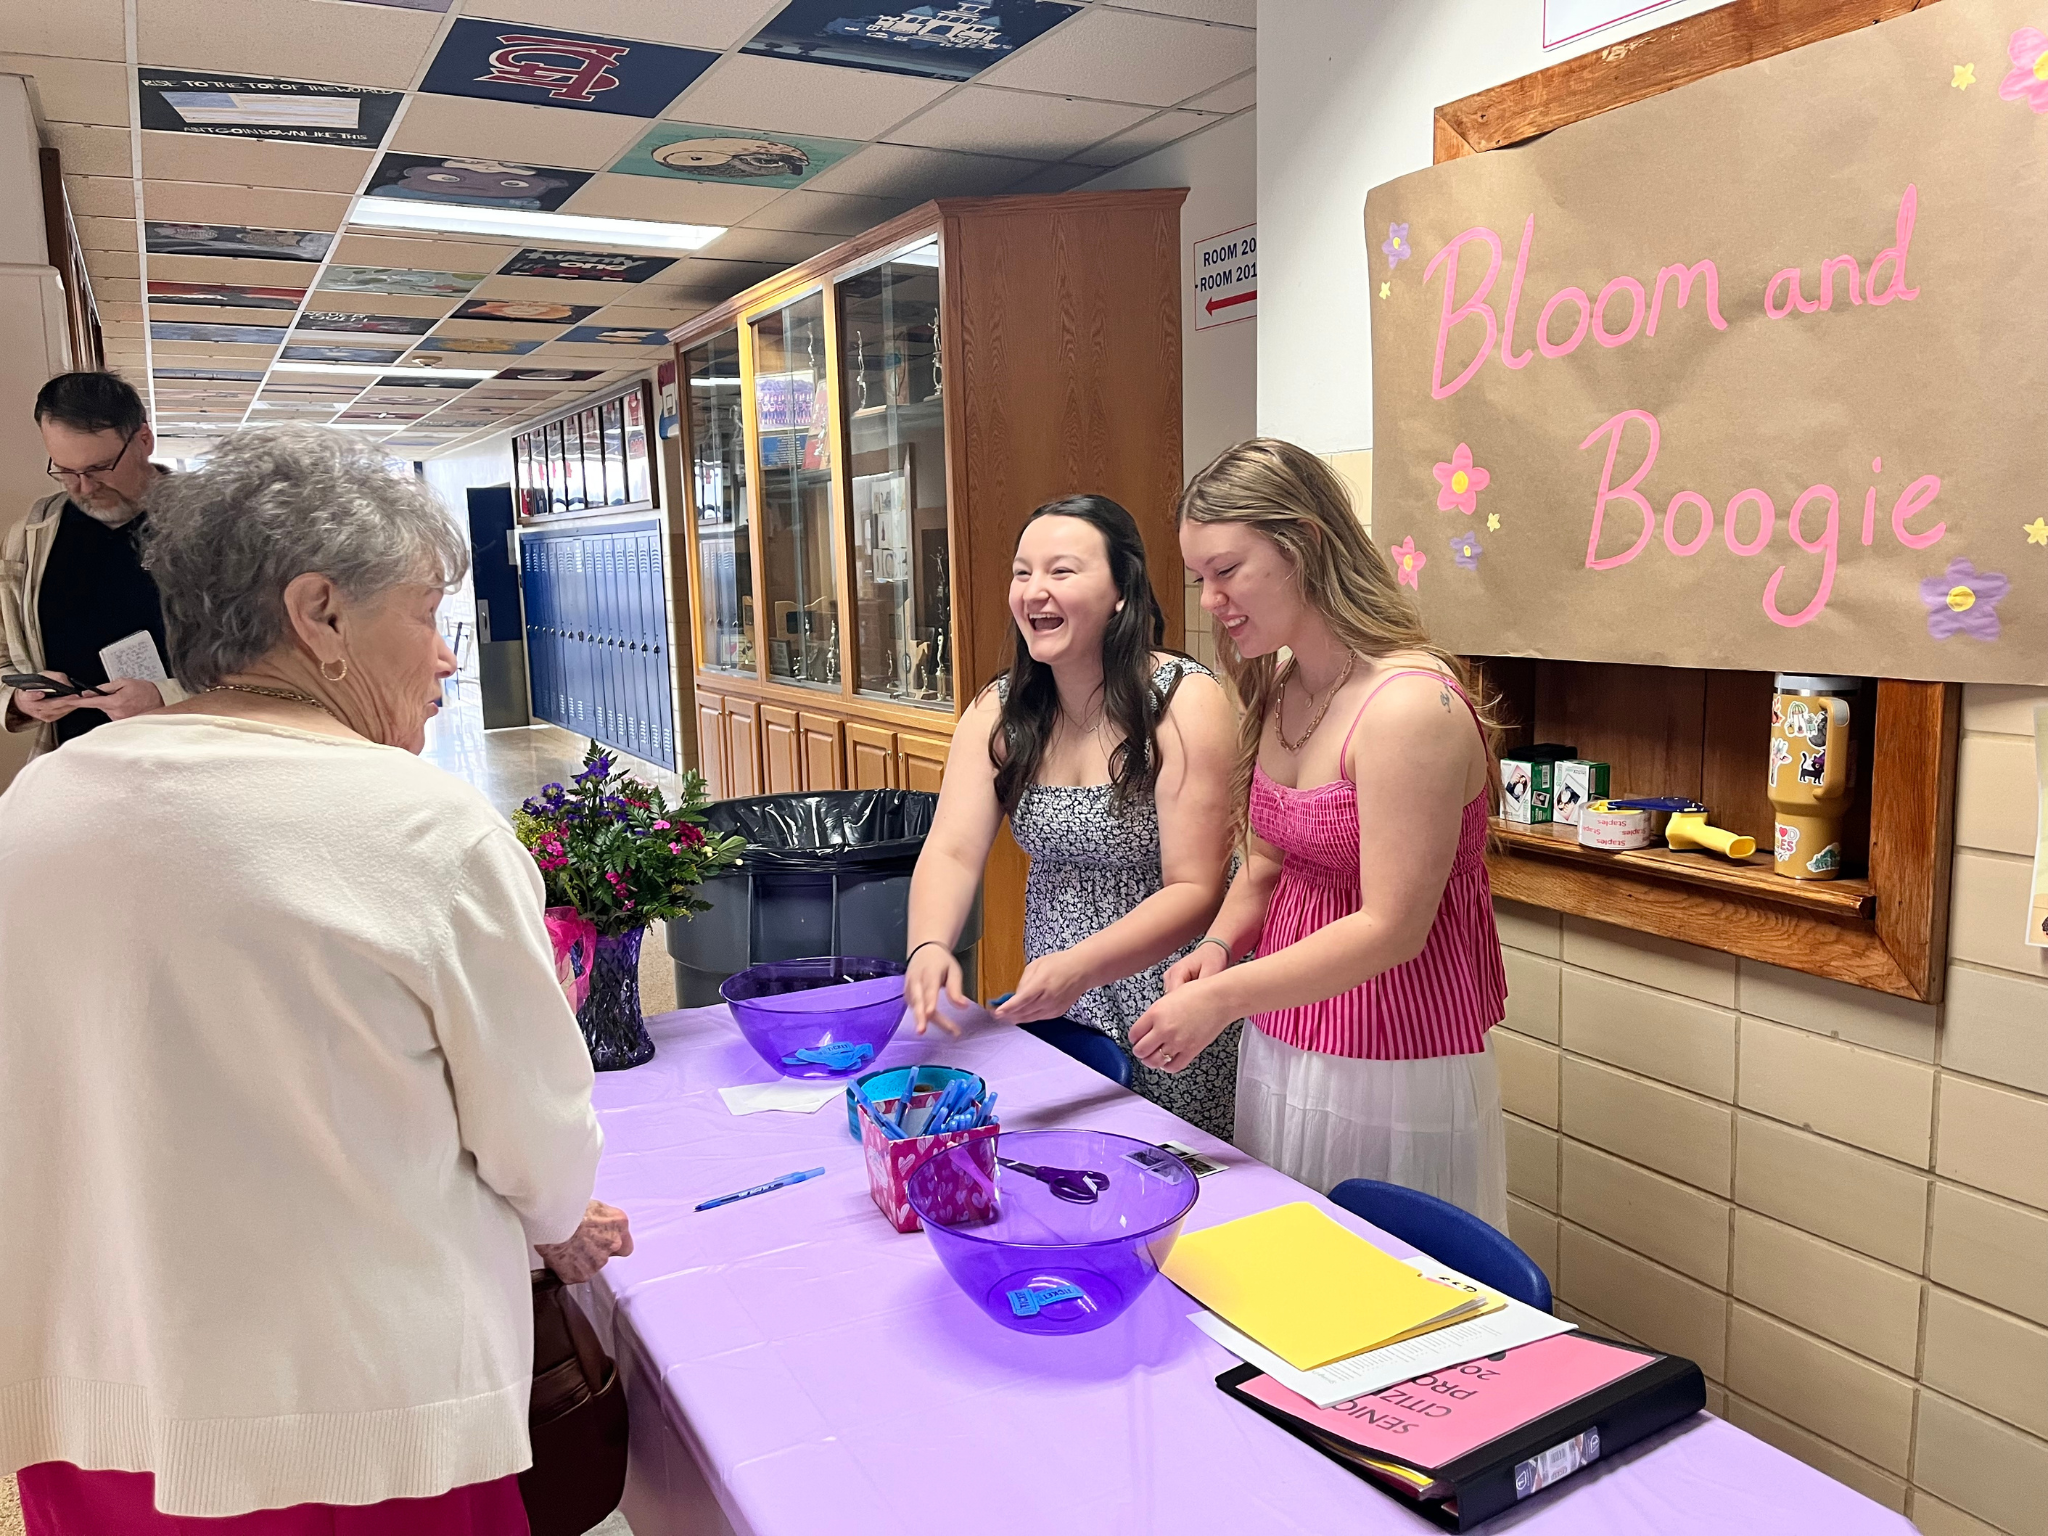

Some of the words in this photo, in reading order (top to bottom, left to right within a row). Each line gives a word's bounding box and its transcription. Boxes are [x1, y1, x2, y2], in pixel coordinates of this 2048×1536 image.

[141, 79, 179, 88] RISE
[181, 80, 208, 88] TO
[208, 81, 244, 89] THE
[243, 82, 276, 90] TOP
[280, 83, 300, 91] OF
[303, 84, 336, 93] THE
[334, 86, 396, 95] WORLD
[336, 132, 368, 140] THIS
[525, 251, 647, 268] twenty
[1203, 242, 1237, 267] ROOM
[559, 261, 627, 271] one
[1200, 268, 1232, 292] ROOM
[1422, 212, 1728, 400] Bloom
[1764, 183, 1921, 320] and
[1579, 408, 1946, 628] Boogie
[1597, 819, 1627, 827] Staples
[1596, 837, 1626, 846] Staples
[1043, 1288, 1072, 1299] TICKET
[1454, 1364, 1501, 1381] 20
[1376, 1388, 1452, 1418] CITIZ
